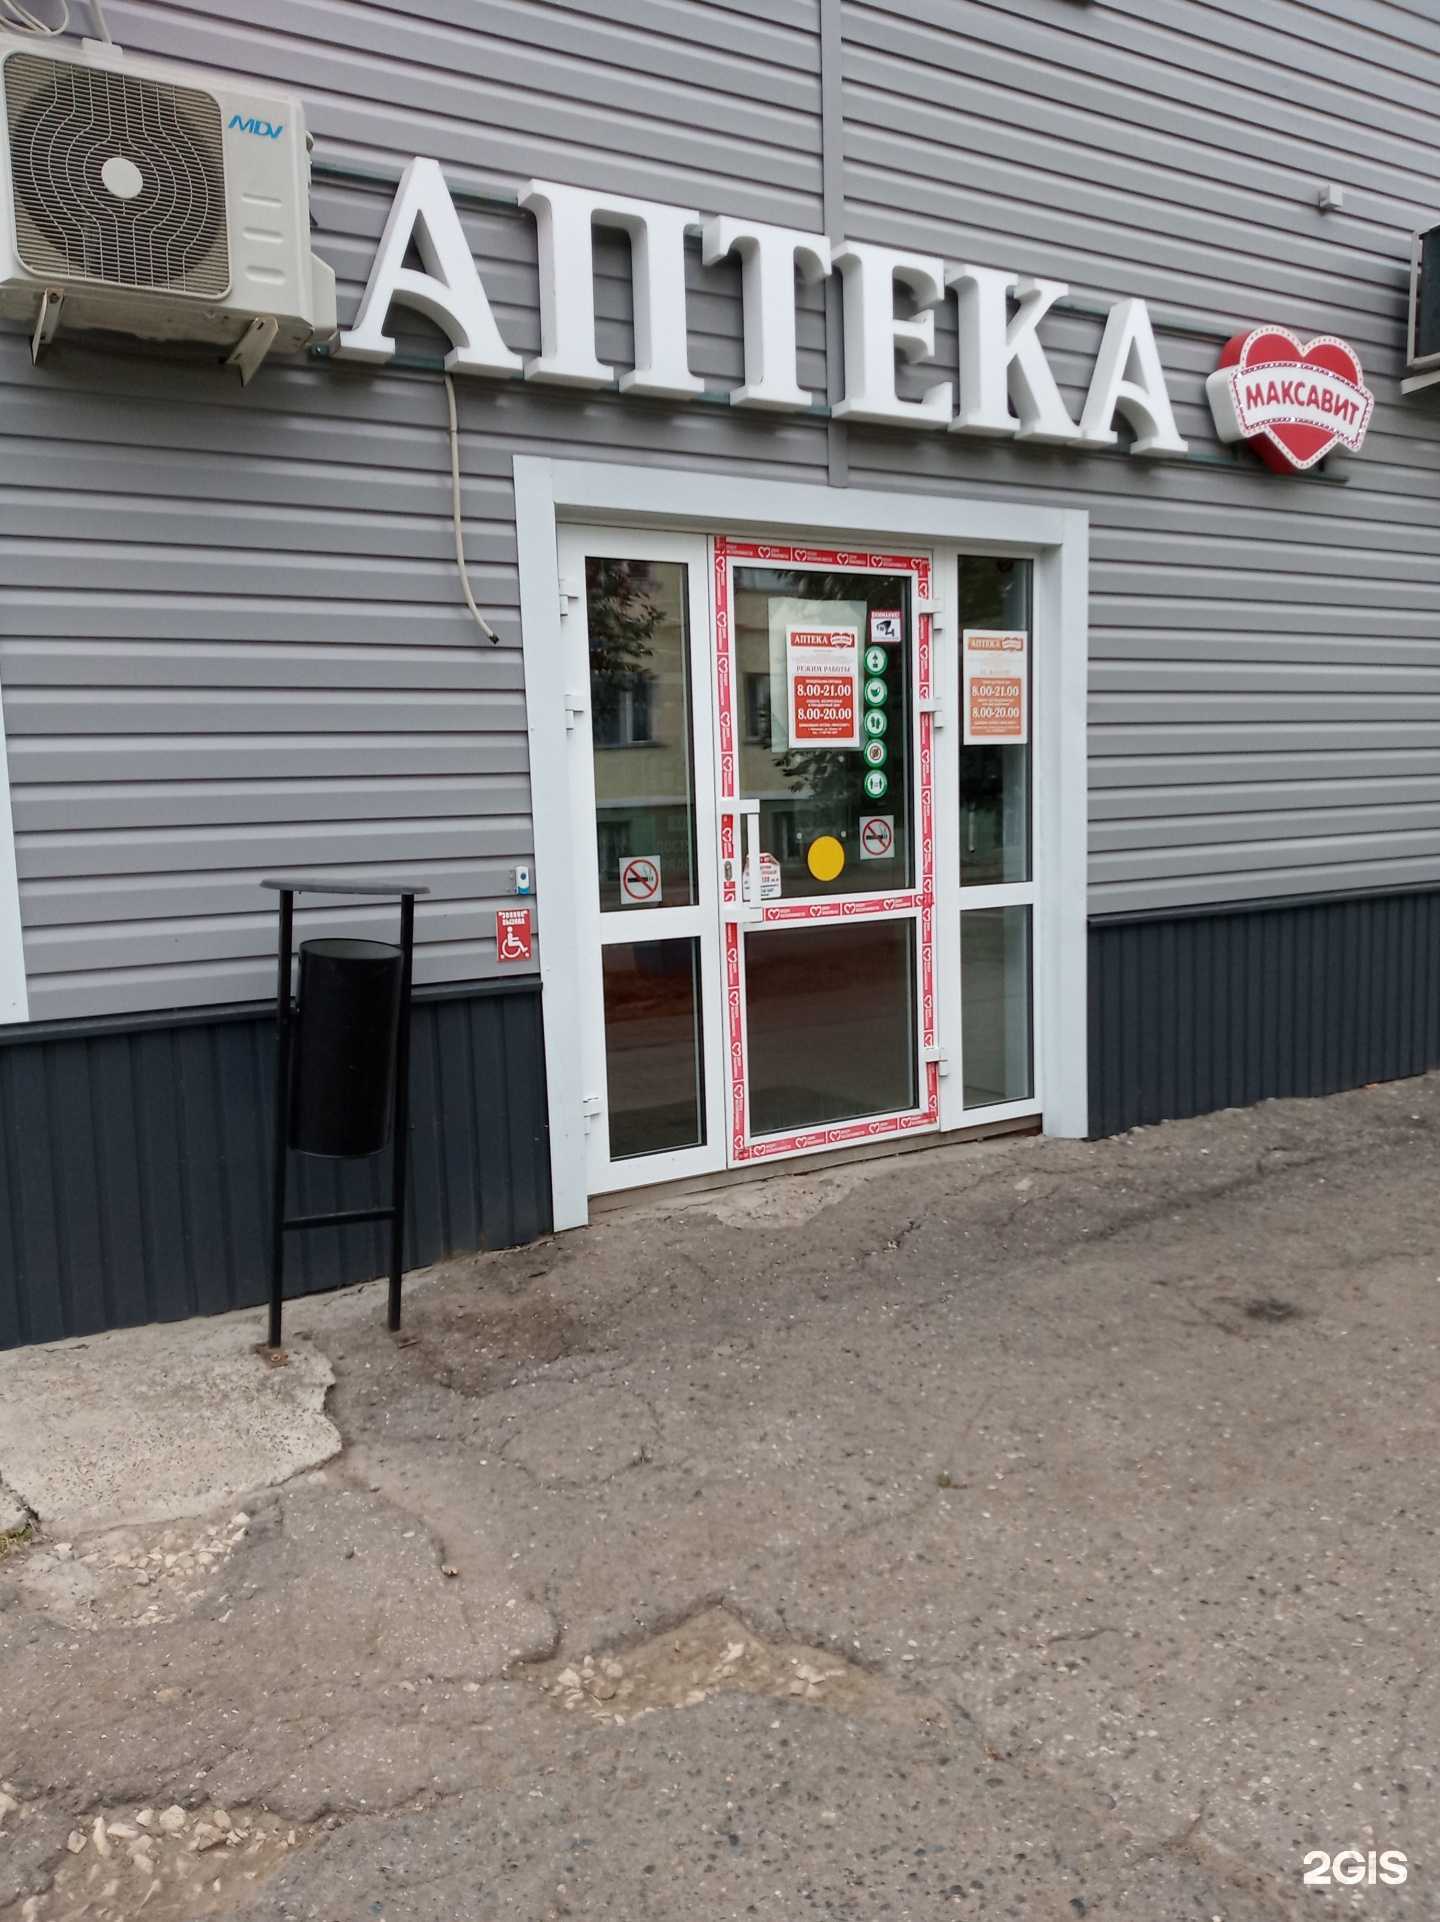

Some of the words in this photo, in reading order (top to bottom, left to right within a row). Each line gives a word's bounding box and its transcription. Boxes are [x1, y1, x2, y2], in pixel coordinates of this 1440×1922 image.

[228, 114, 284, 139] MDV
[335, 157, 1190, 456] АПТЕКА
[1244, 380, 1360, 426] МАКСАВИТ
[794, 633, 829, 645] АПТЕКА
[797, 684, 852, 697] 8.00-21.00
[971, 685, 1020, 697] 8.00-21.00
[798, 708, 852, 720] 8.00-20.00
[972, 706, 1020, 718] 8.00-20.00
